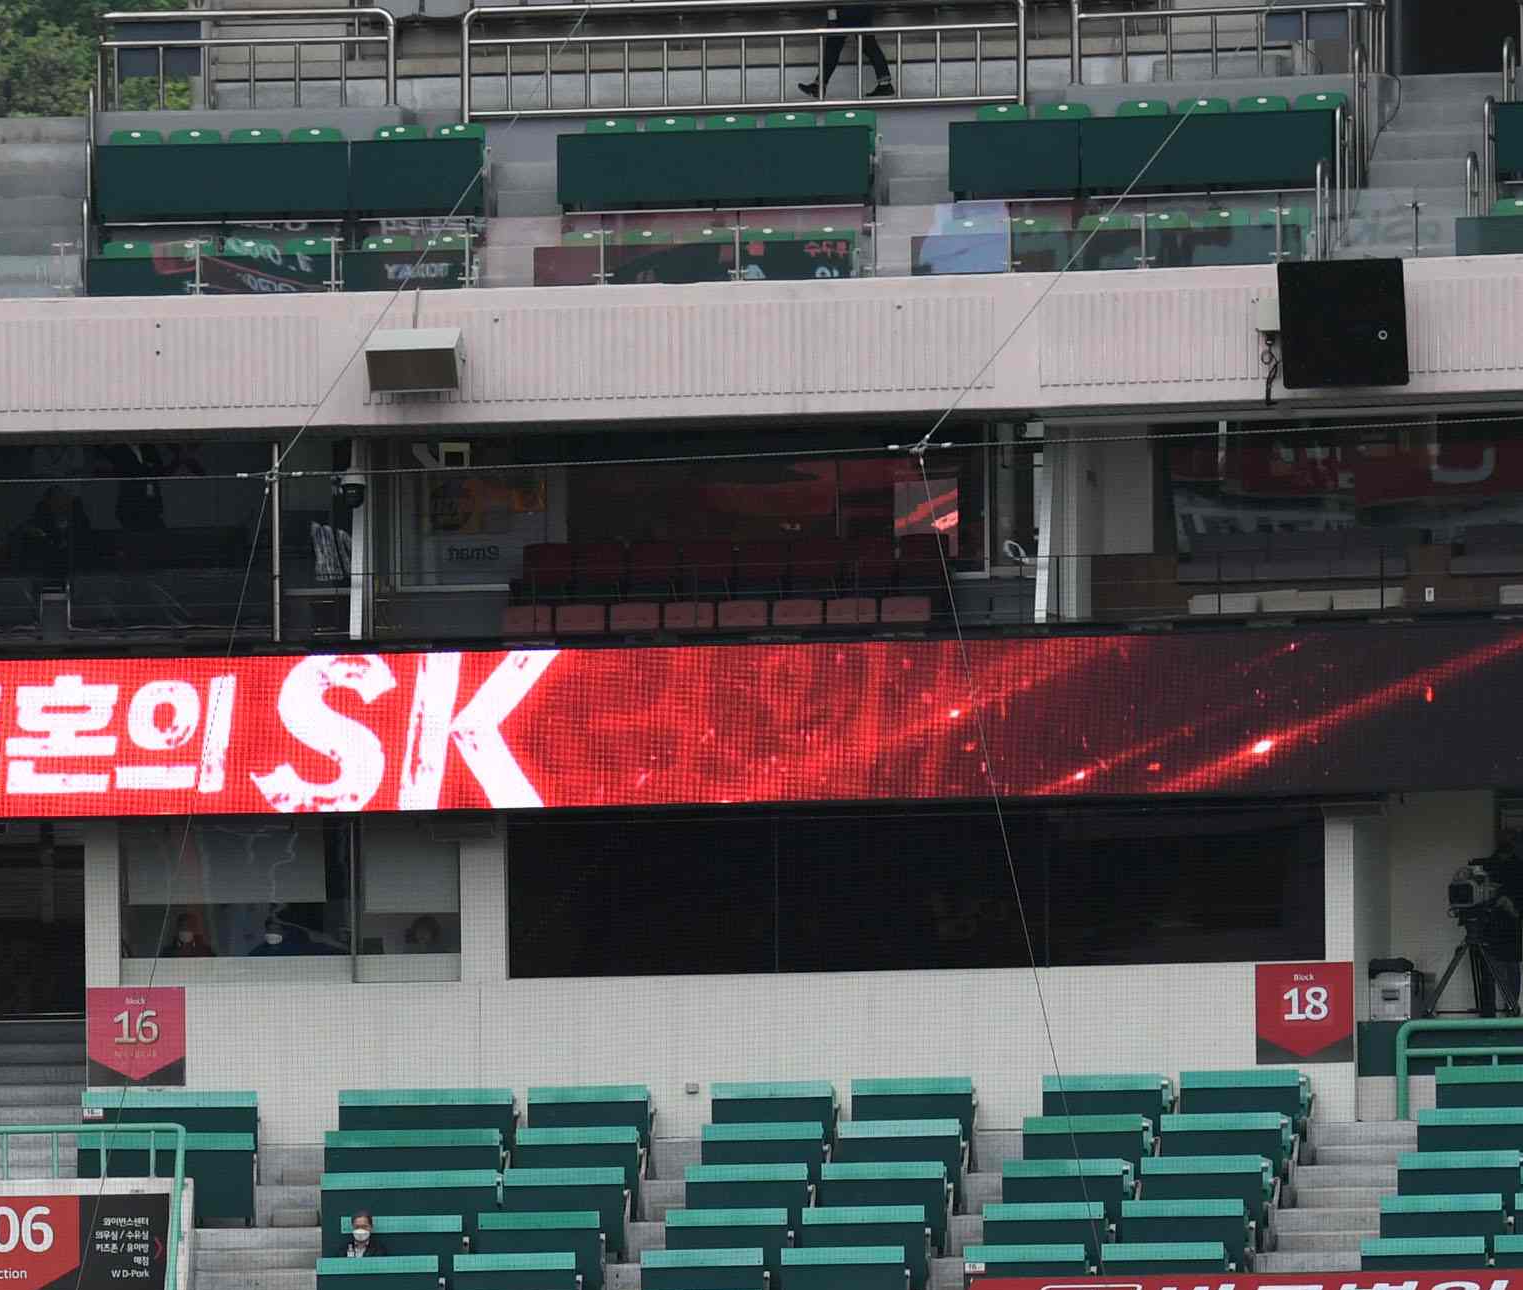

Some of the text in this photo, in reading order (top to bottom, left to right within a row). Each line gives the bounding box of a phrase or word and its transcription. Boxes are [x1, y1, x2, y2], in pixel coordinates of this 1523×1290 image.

[249, 649, 563, 812] SK
[1283, 986, 1329, 1021] 18
[113, 1009, 160, 1044] 16
